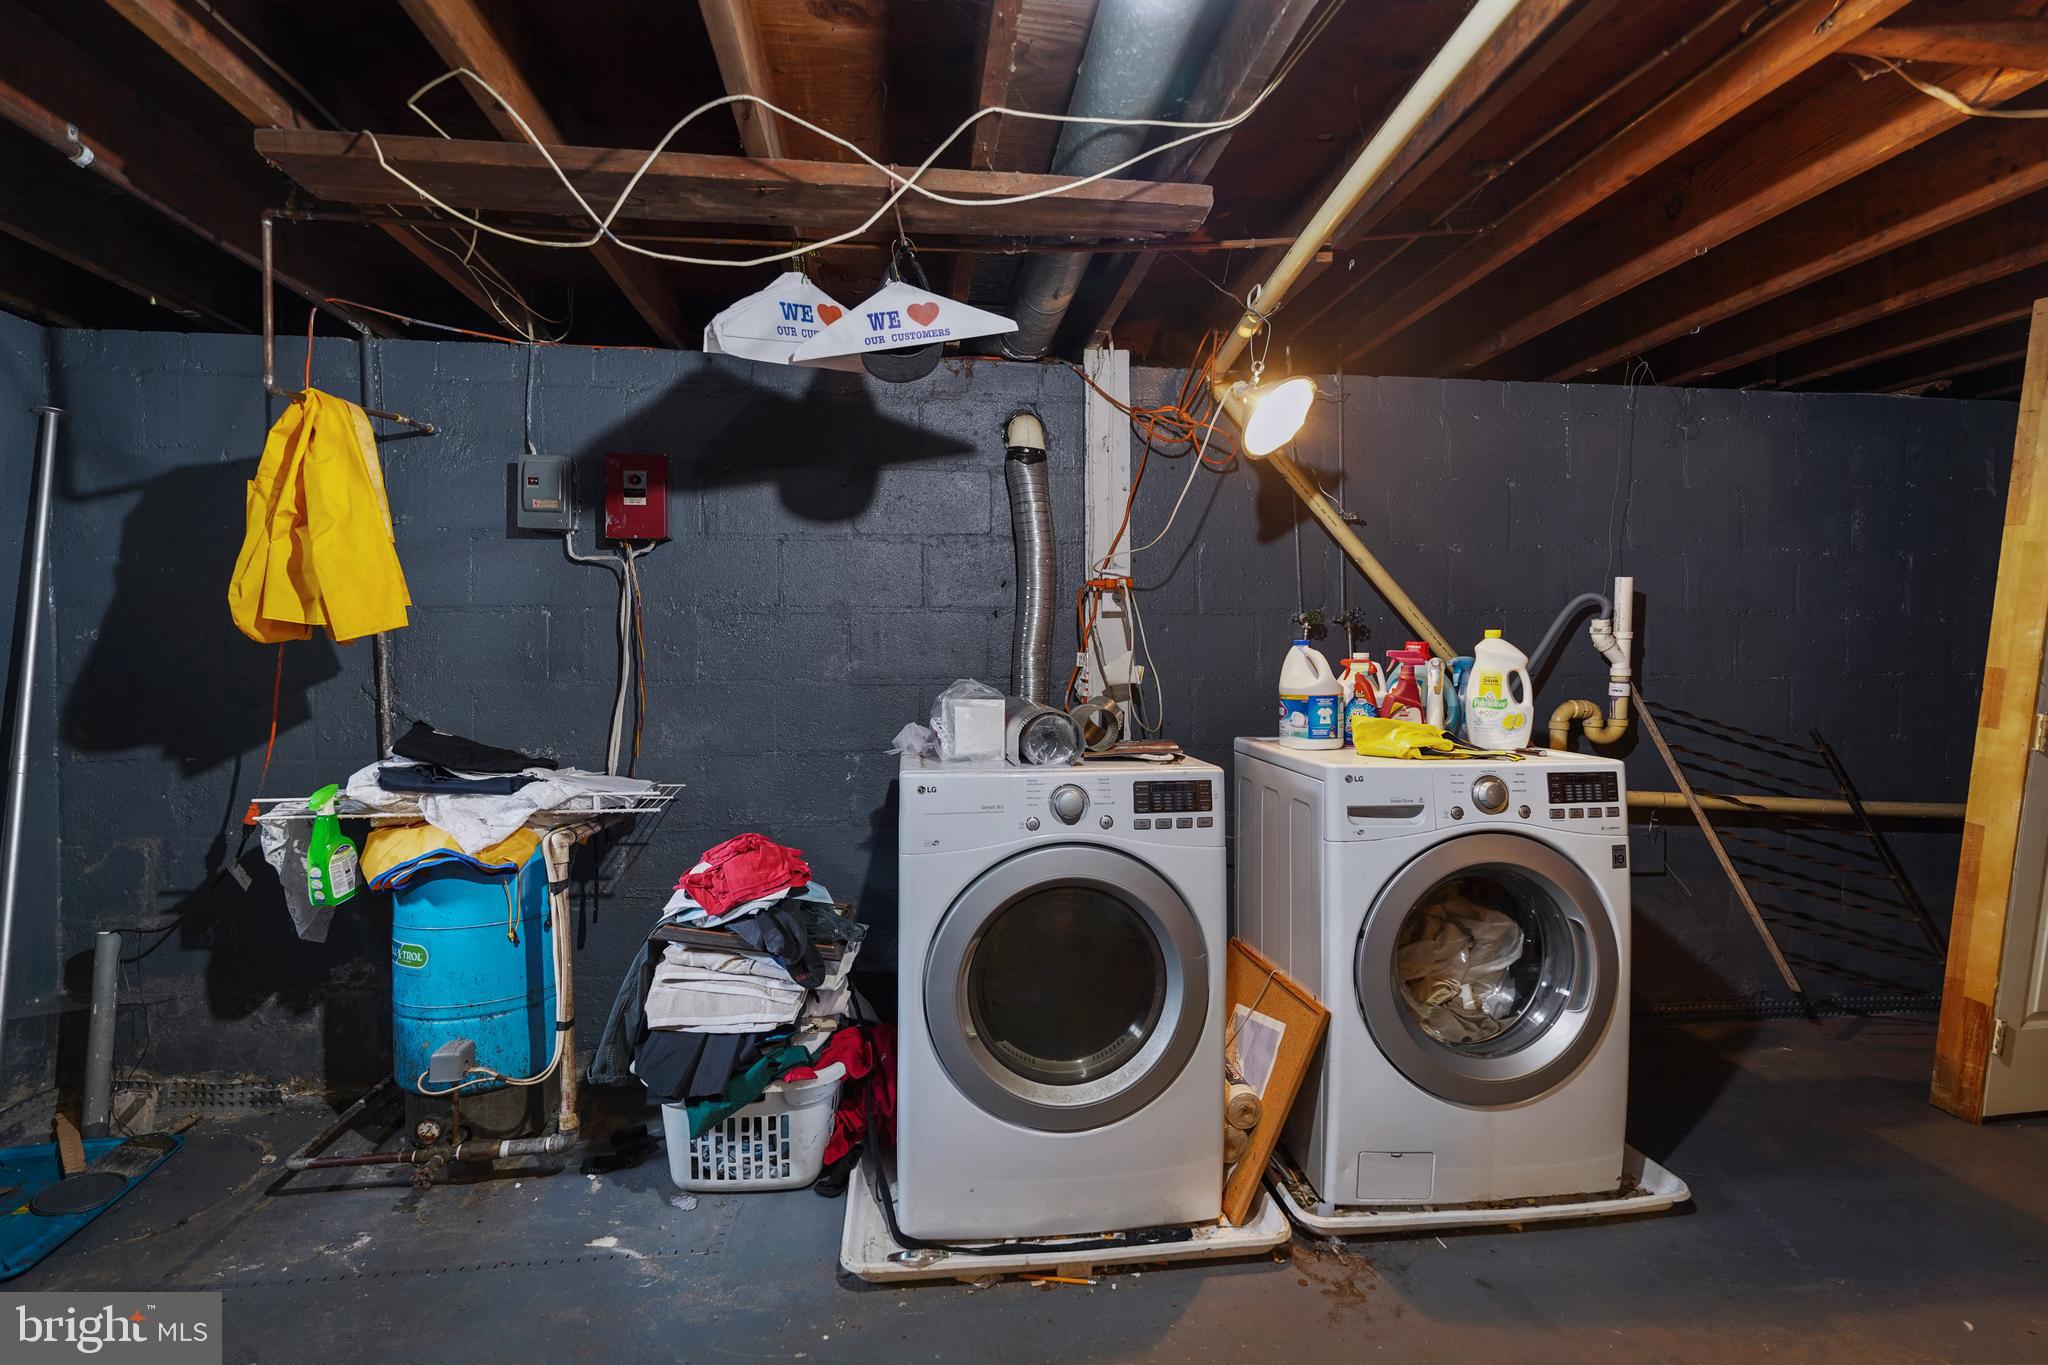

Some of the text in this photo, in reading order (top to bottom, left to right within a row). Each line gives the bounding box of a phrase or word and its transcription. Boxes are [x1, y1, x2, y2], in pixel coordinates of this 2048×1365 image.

[779, 301, 814, 323] WE
[867, 311, 901, 331] WE
[777, 325, 798, 337] OUR
[864, 328, 951, 346] OUR CUSTOMERS
